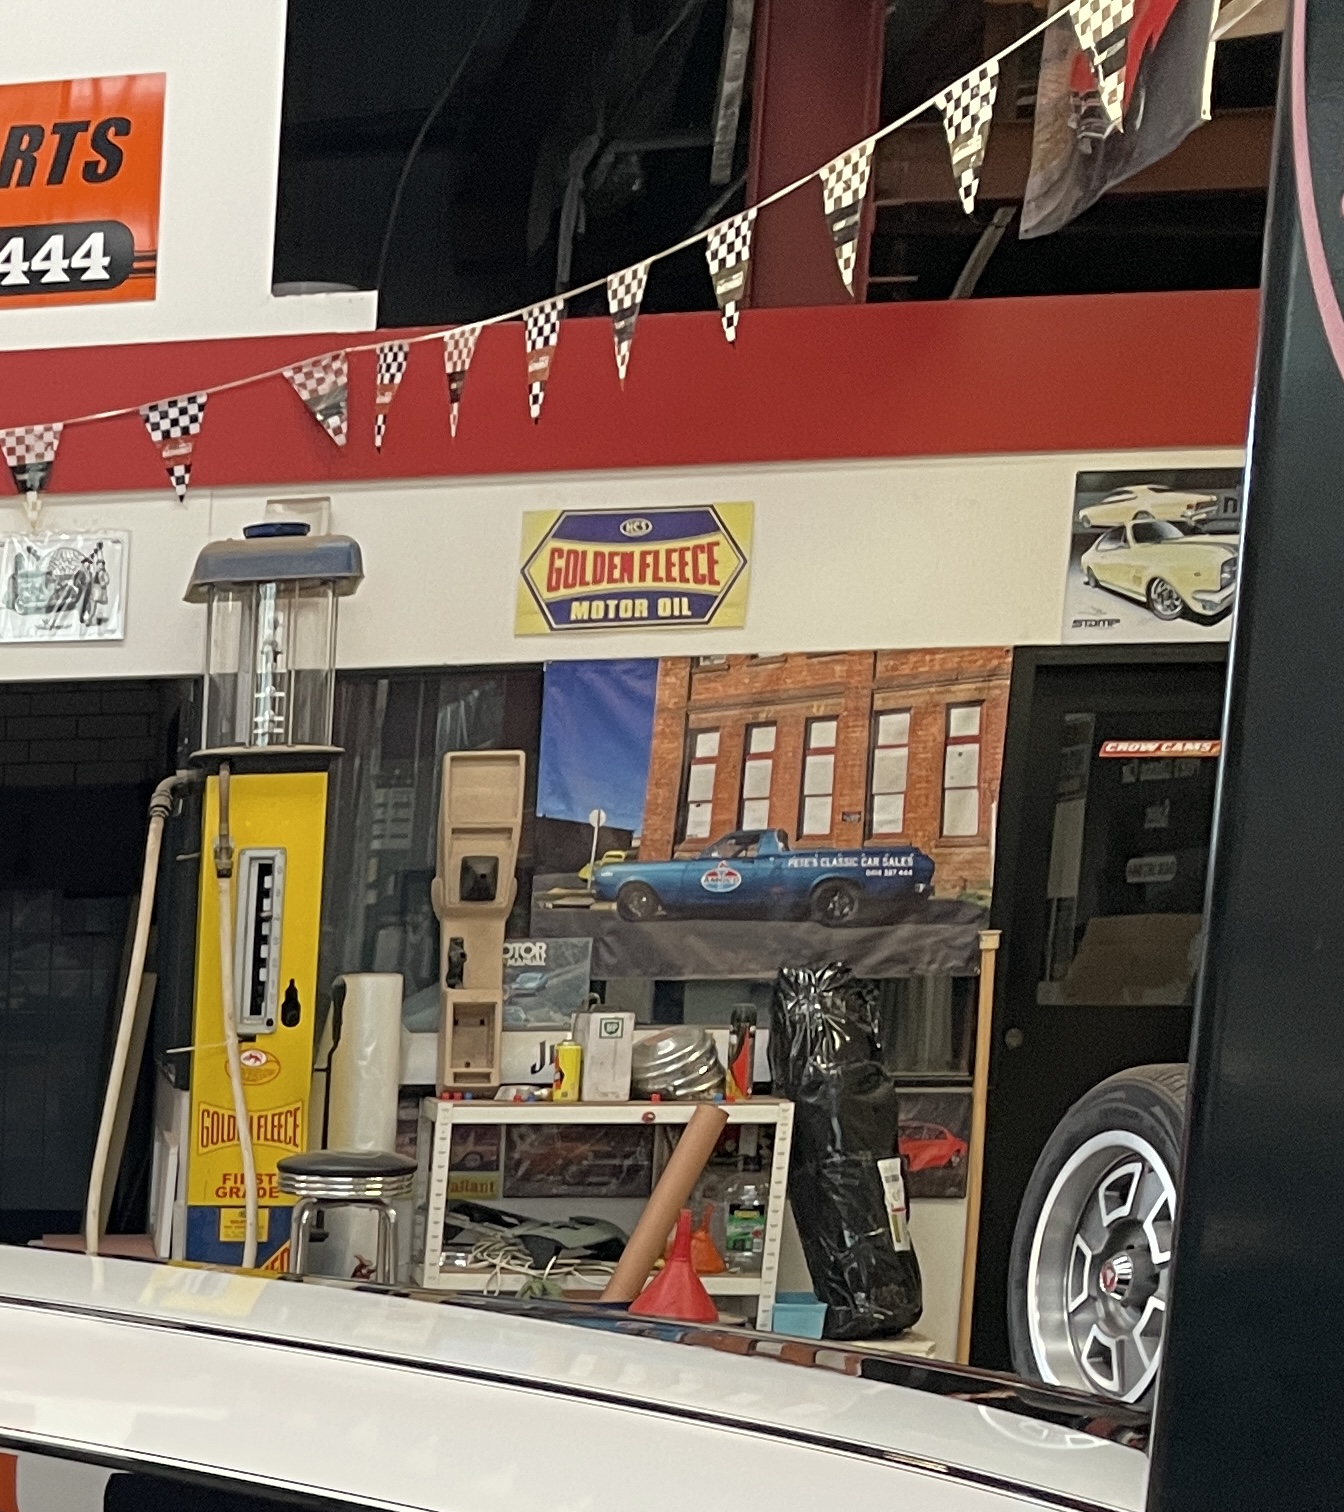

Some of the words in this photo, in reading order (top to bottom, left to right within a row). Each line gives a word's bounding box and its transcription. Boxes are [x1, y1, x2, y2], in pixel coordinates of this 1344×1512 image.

[546, 546, 636, 593] GOLDEN
[638, 541, 721, 586] FLEECE
[569, 598, 649, 621] MOTOR
[657, 596, 692, 617] OIL
[1105, 742, 1160, 752] CROW
[1161, 742, 1213, 752] CAMS
[502, 941, 548, 959] OTOR
[256, 1106, 301, 1148] FLEECE
